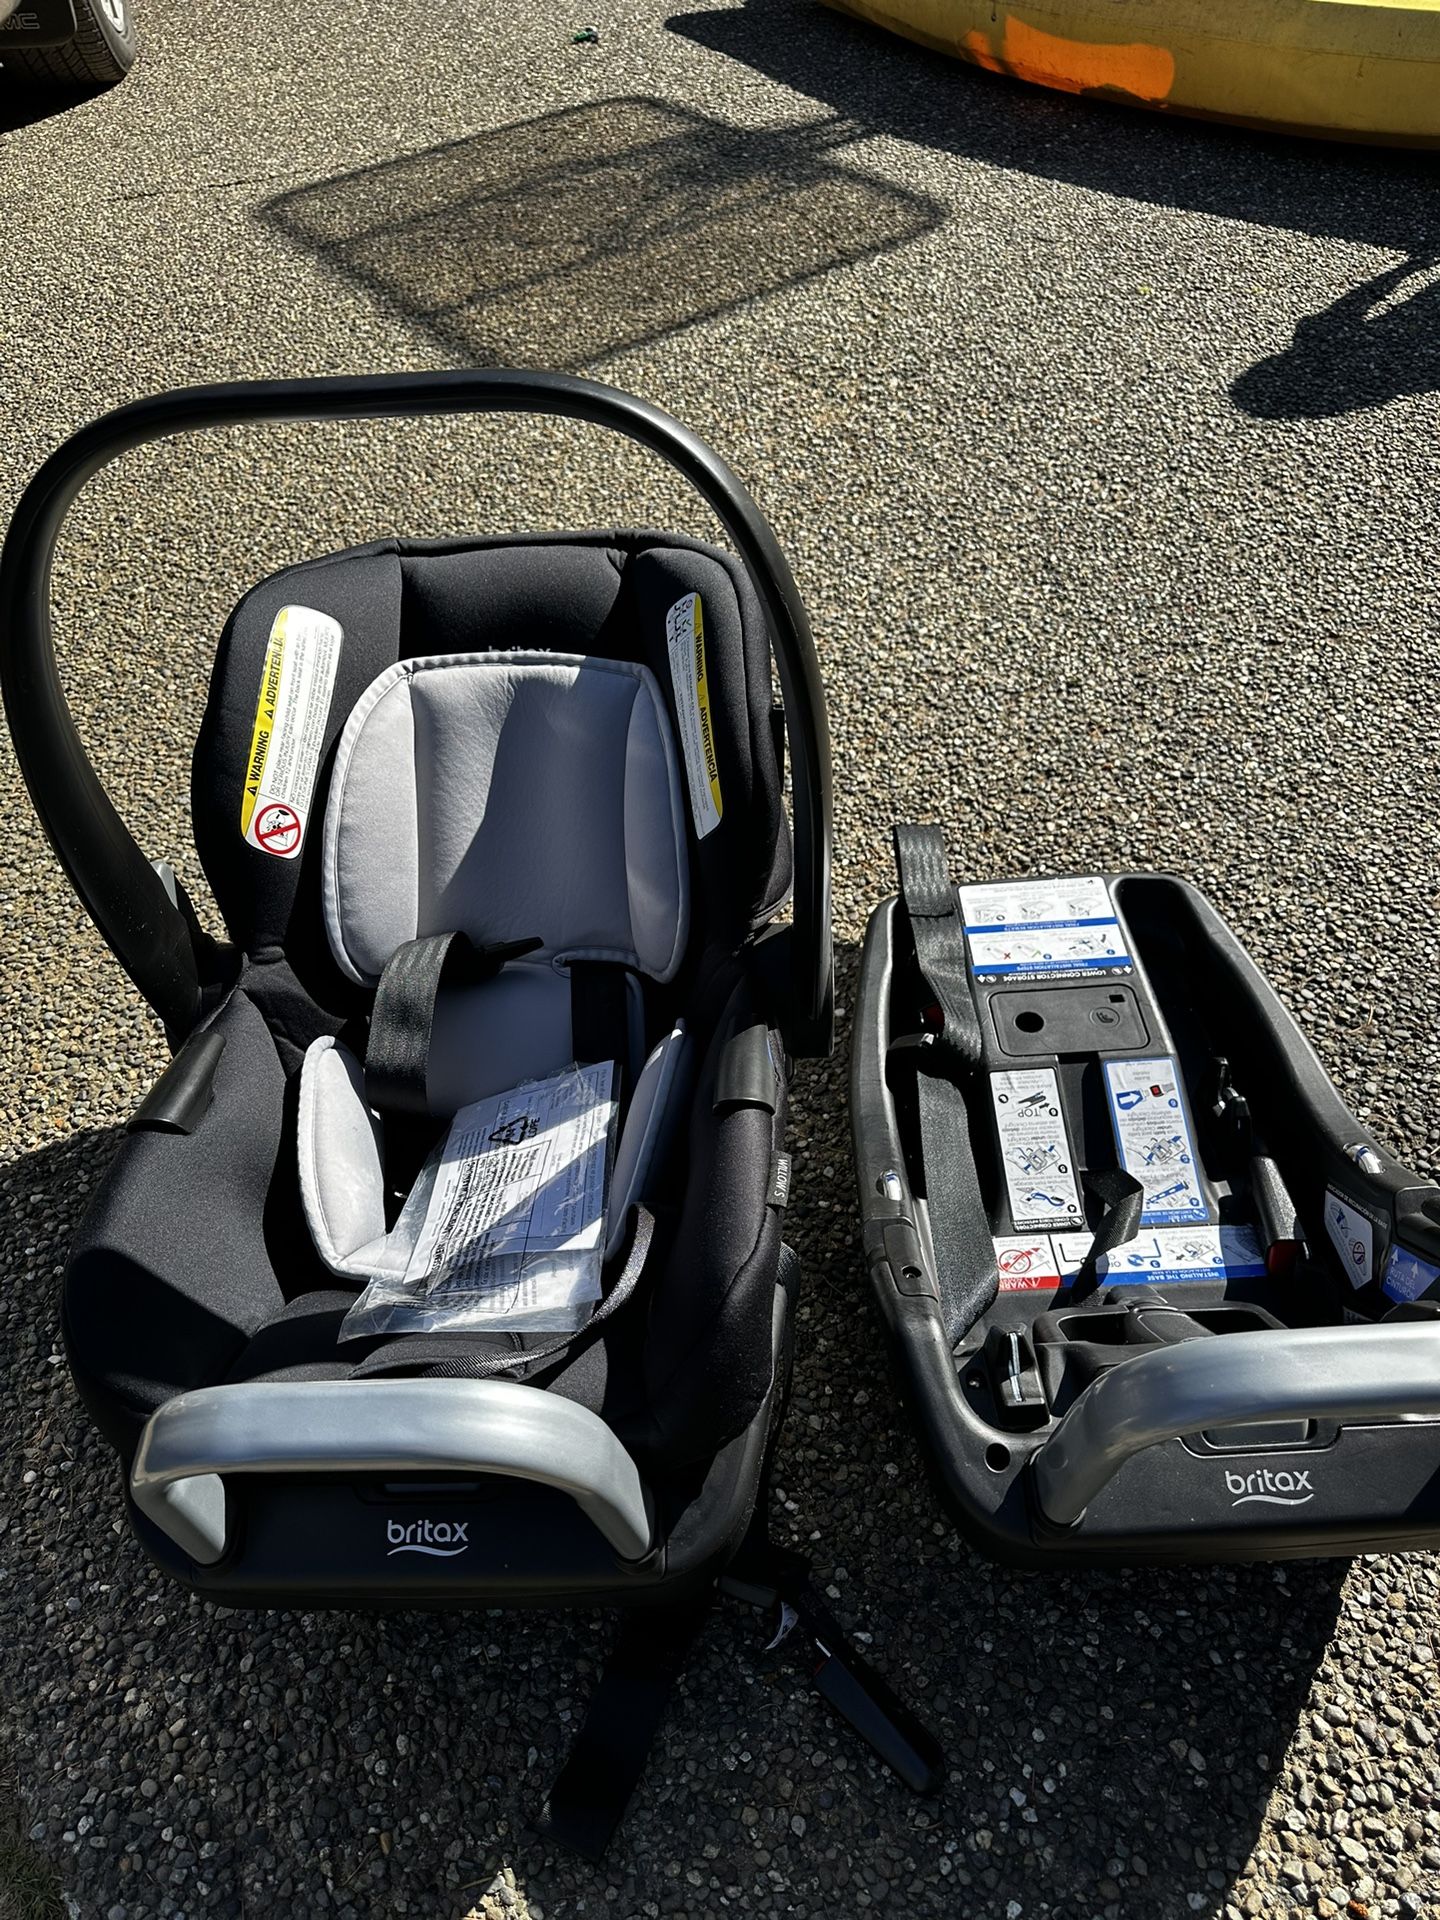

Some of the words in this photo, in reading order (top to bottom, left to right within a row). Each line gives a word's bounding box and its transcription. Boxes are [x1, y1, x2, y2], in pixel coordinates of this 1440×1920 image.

[0, 13, 40, 30] MC
[695, 631, 704, 683] WARNING
[699, 706, 719, 783] ADVERTENCIA
[249, 730, 270, 781] WARNING
[1002, 973, 1035, 981] STORAGE
[1035, 970, 1081, 979] CONNECTOR
[1017, 1107, 1041, 1117] TOP
[1146, 1273, 1164, 1281] BASE
[1179, 1269, 1220, 1278] INSTALLING
[1225, 1469, 1313, 1494] britax
[387, 1519, 469, 1544] britax
